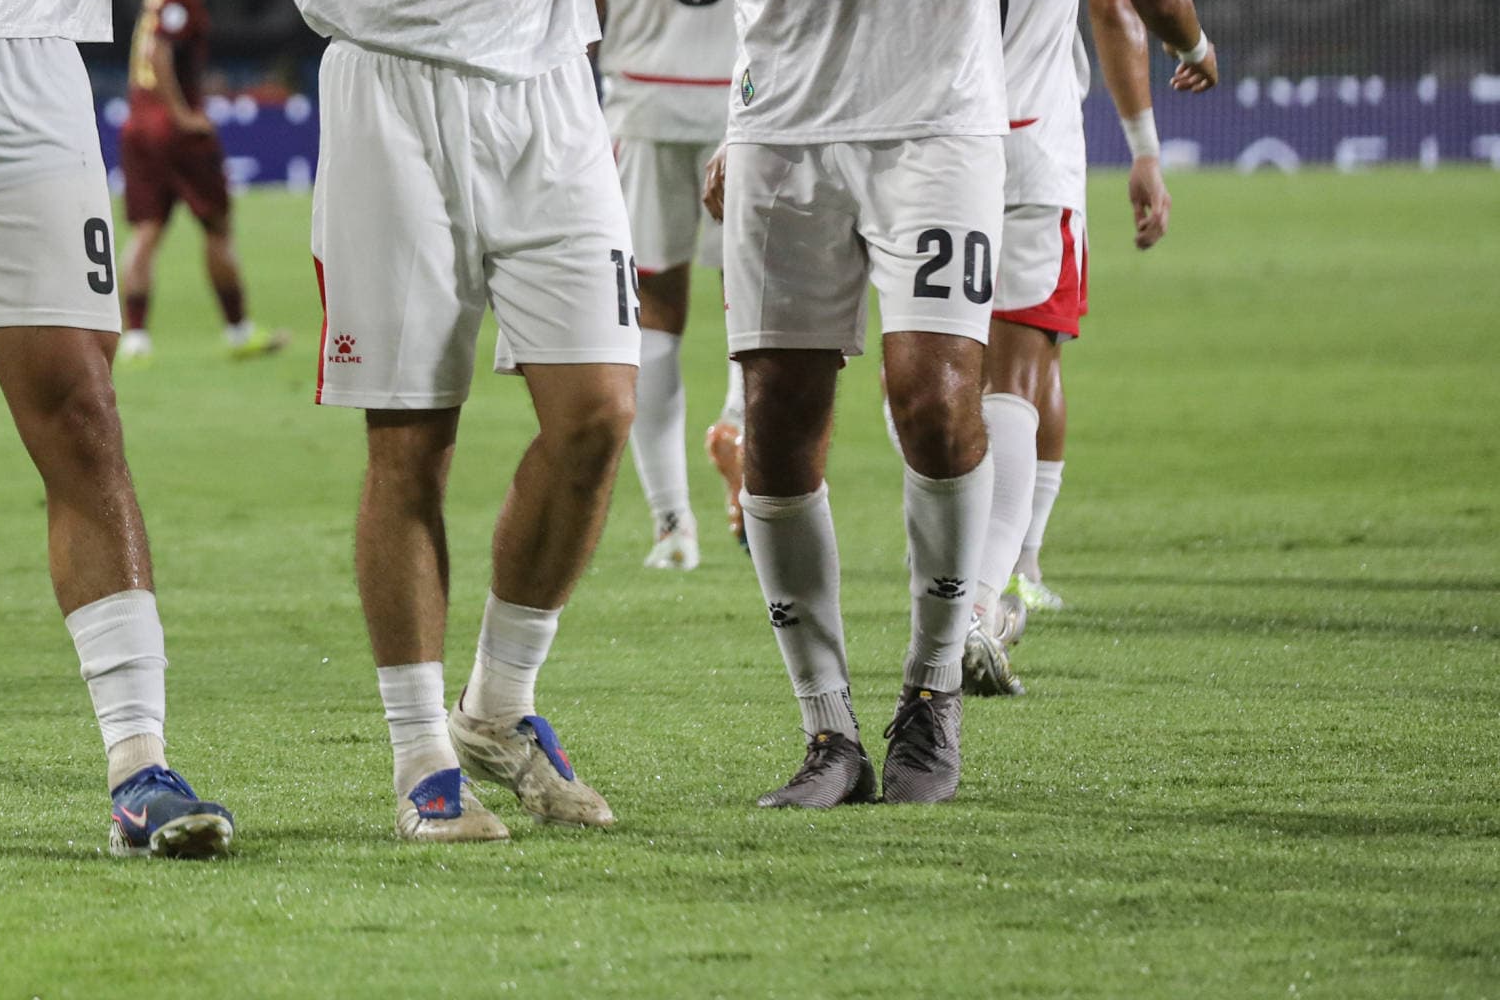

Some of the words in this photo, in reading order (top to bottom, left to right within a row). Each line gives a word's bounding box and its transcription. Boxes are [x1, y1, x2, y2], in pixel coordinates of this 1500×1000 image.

[83, 217, 114, 295] 9
[913, 229, 993, 305] 20
[328, 355, 362, 364] KELME
